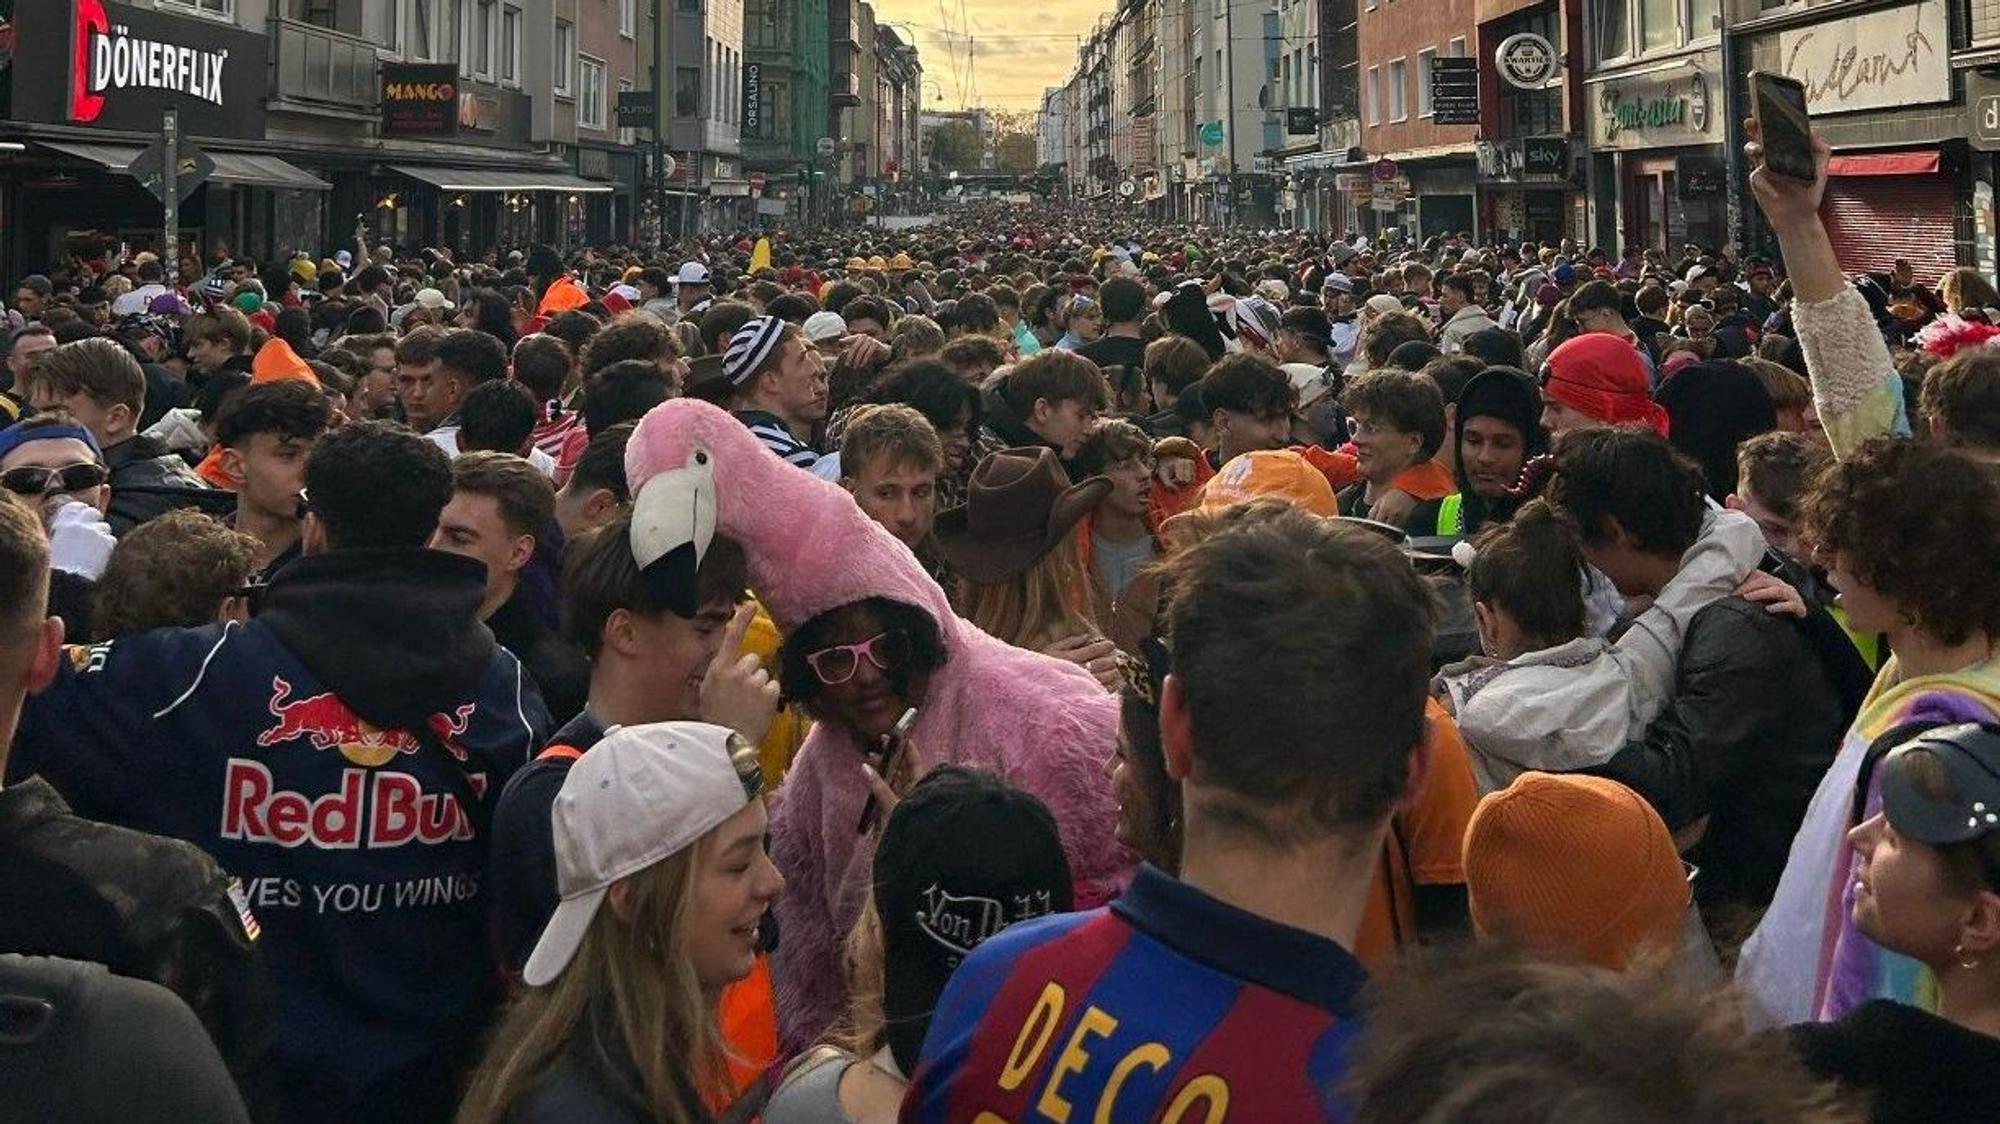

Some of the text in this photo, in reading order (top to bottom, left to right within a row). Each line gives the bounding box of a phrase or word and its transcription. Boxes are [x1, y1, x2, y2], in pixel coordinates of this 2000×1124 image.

[94, 25, 223, 105] DÖNERFLIX
[385, 83, 456, 101] MANGO
[1530, 149, 1561, 166] sky
[221, 758, 488, 849] Red Bu
[243, 874, 479, 915] VES YOU WINGS
